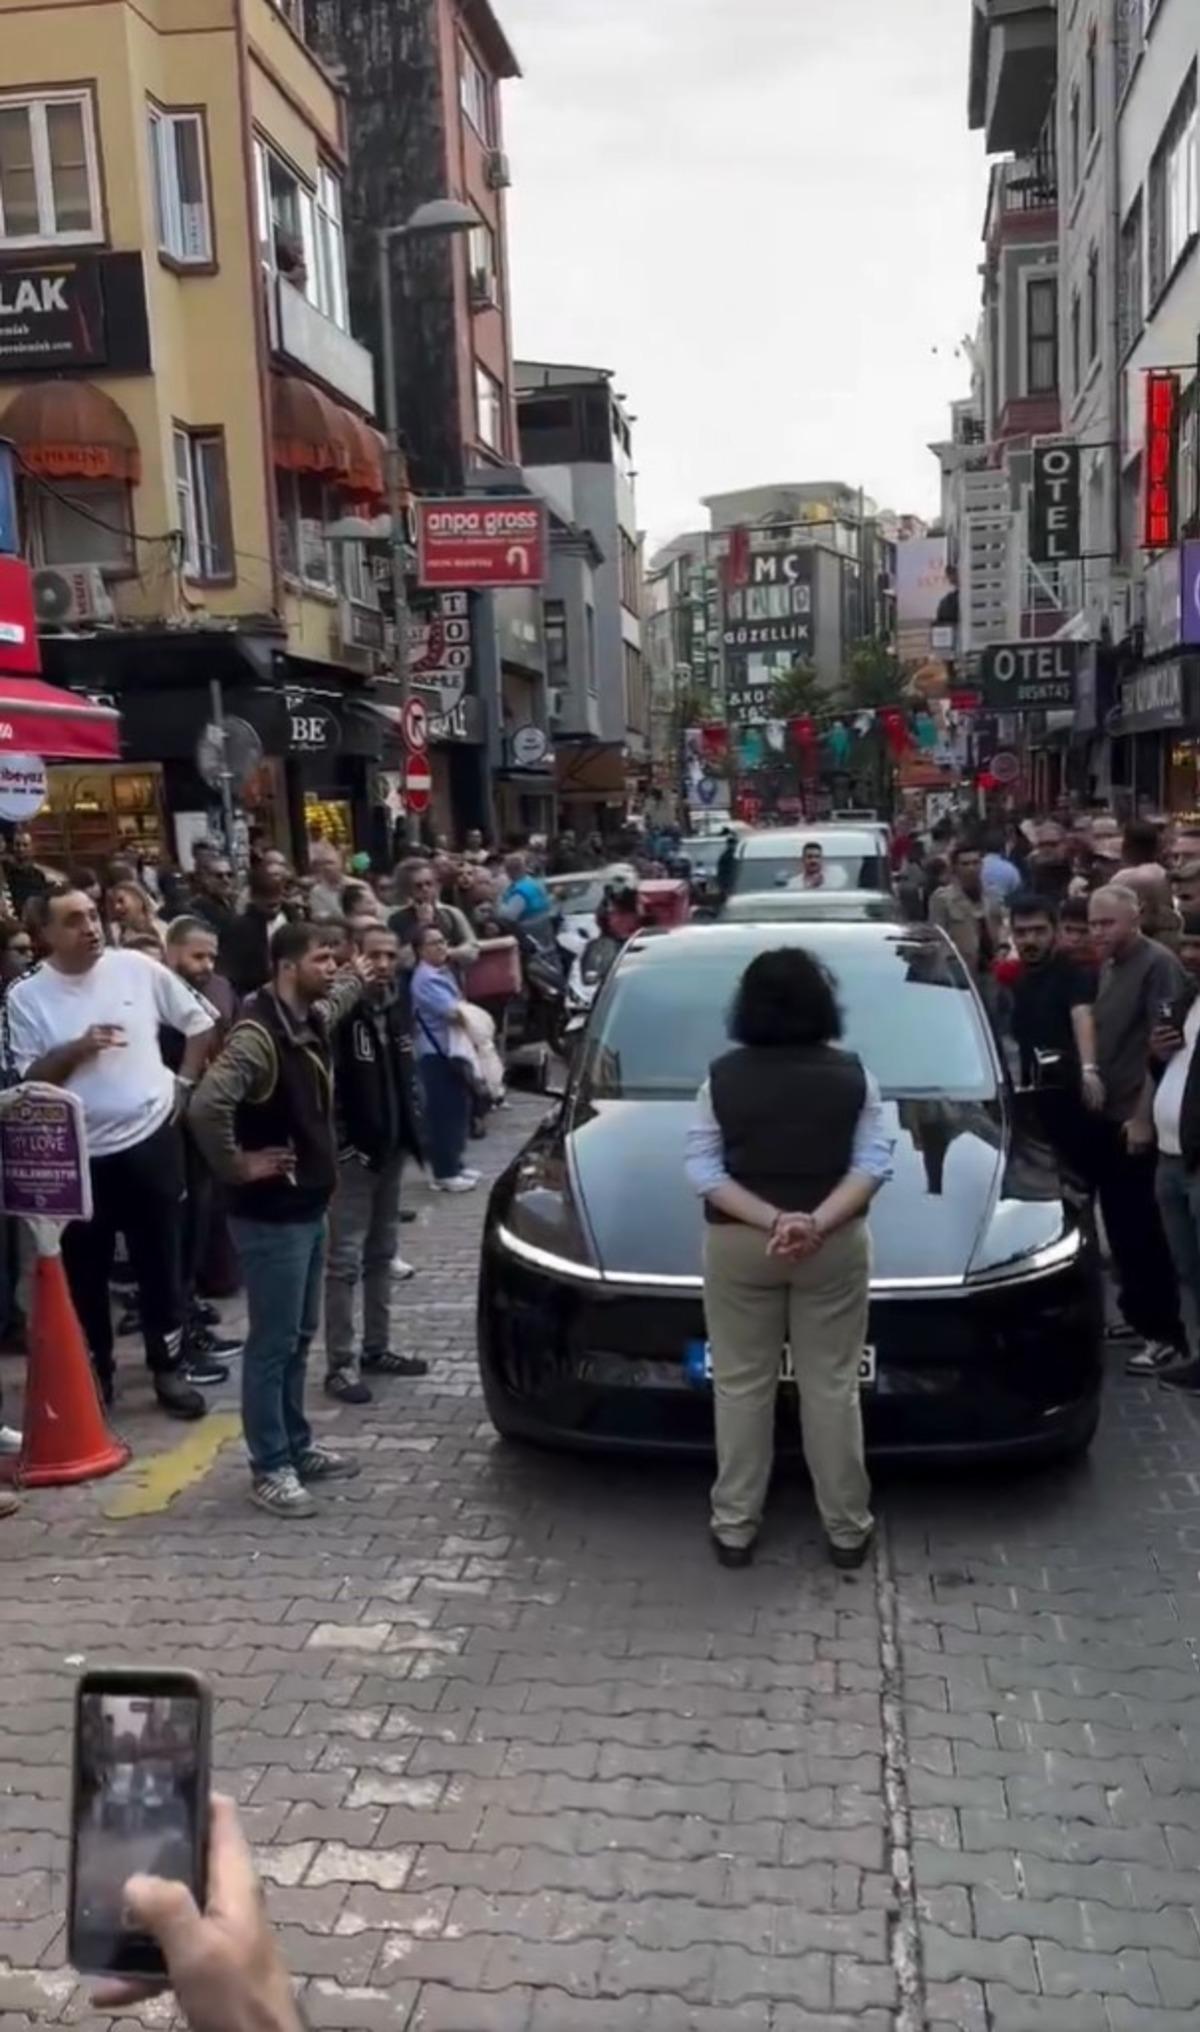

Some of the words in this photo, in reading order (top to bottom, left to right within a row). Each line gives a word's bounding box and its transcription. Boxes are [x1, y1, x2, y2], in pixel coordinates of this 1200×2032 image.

[1042, 451, 1071, 558] OTEL
[427, 512, 480, 534] anpa
[484, 510, 539, 537] gross
[994, 649, 1070, 681] OTEL
[291, 716, 327, 742] BE
